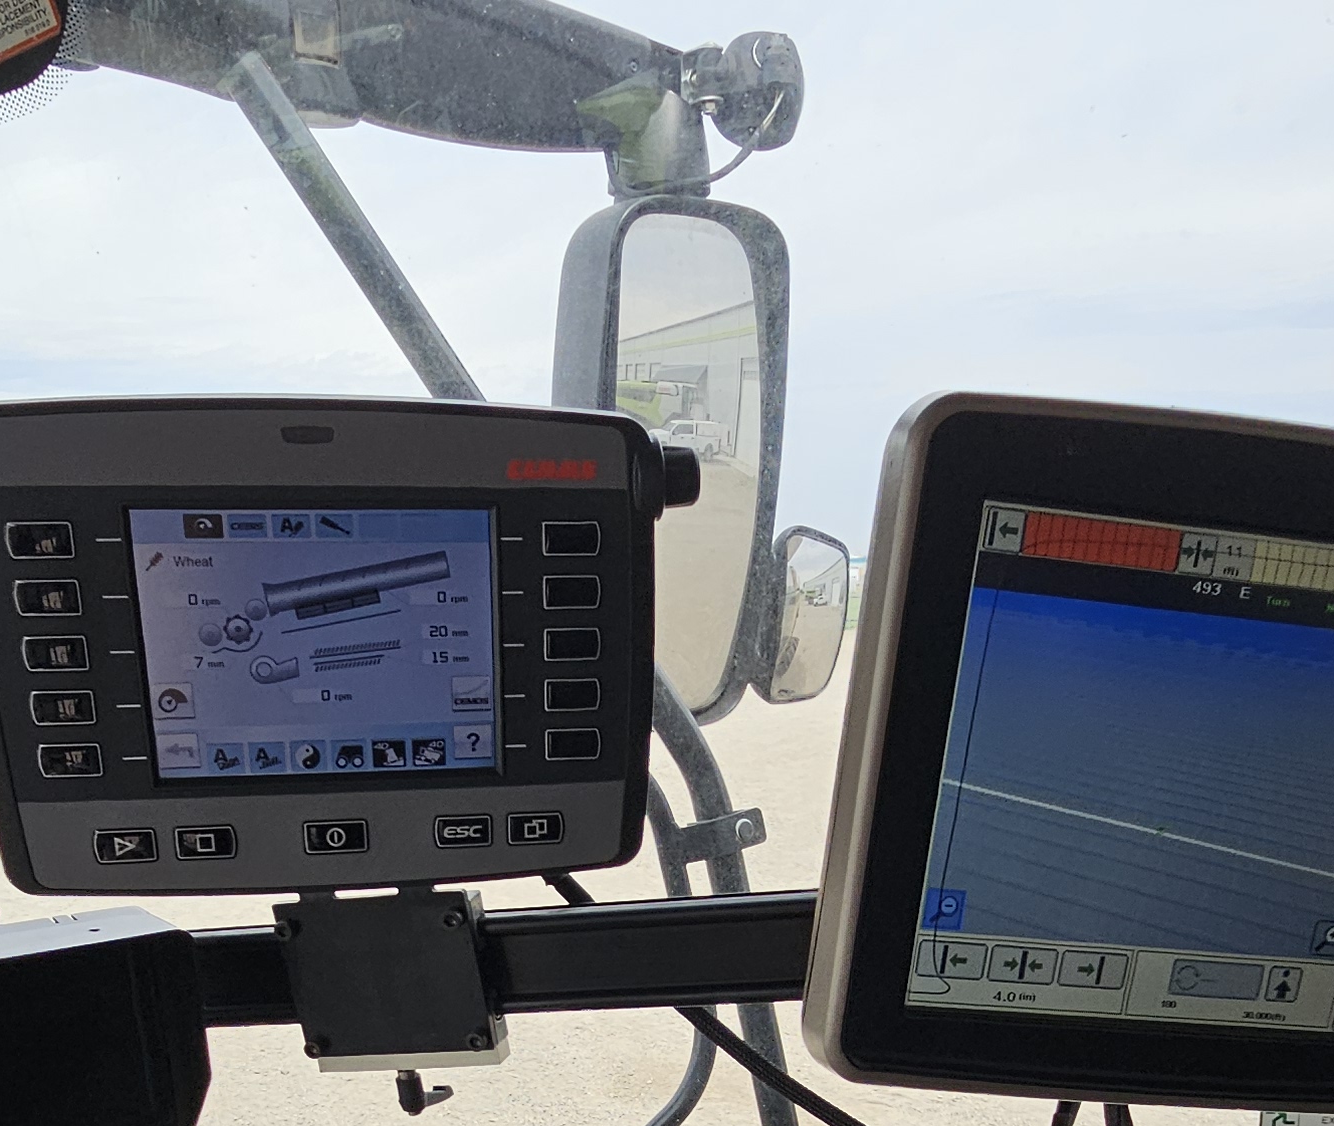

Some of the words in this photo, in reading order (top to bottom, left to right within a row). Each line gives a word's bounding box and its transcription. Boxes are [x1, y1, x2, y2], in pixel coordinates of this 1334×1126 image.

[173, 556, 213, 568] Wheat
[1192, 581, 1223, 596] 493
[1239, 586, 1252, 599] E
[188, 593, 198, 606] 0
[437, 591, 447, 603] 0
[429, 625, 448, 638] 20
[194, 656, 204, 668] 7
[432, 652, 449, 664] 15
[321, 690, 331, 701] 0
[443, 825, 483, 839] ESC
[992, 991, 1017, 1003] 4.0
[1018, 992, 1036, 1003] (in)
